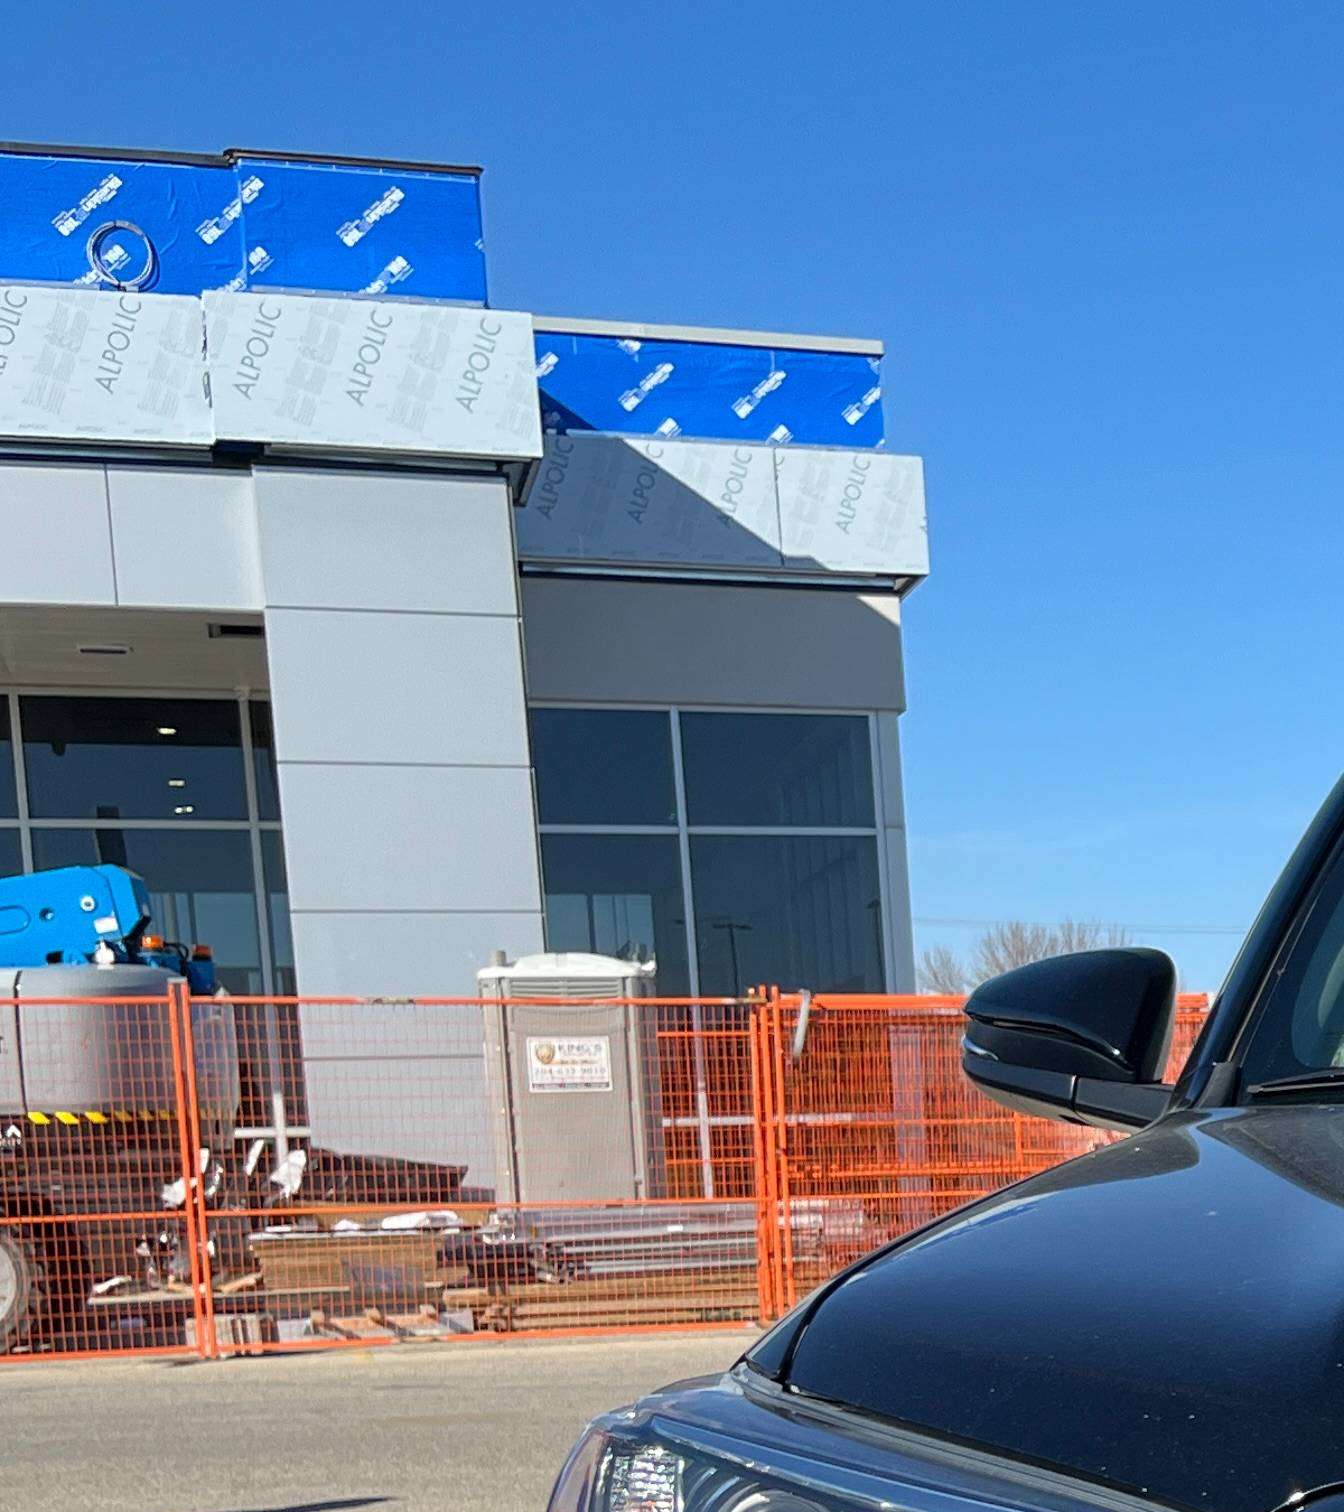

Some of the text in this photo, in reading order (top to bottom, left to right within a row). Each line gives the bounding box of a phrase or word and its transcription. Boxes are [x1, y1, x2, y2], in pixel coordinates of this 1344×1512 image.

[94, 295, 142, 394] ALPOLIC
[232, 301, 281, 400] ALPOLIC
[346, 309, 393, 407] ALPOLIC
[455, 317, 502, 414] ALPOLIC
[535, 436, 574, 520] ALPOLIC
[835, 455, 871, 535] ALPOLIC
